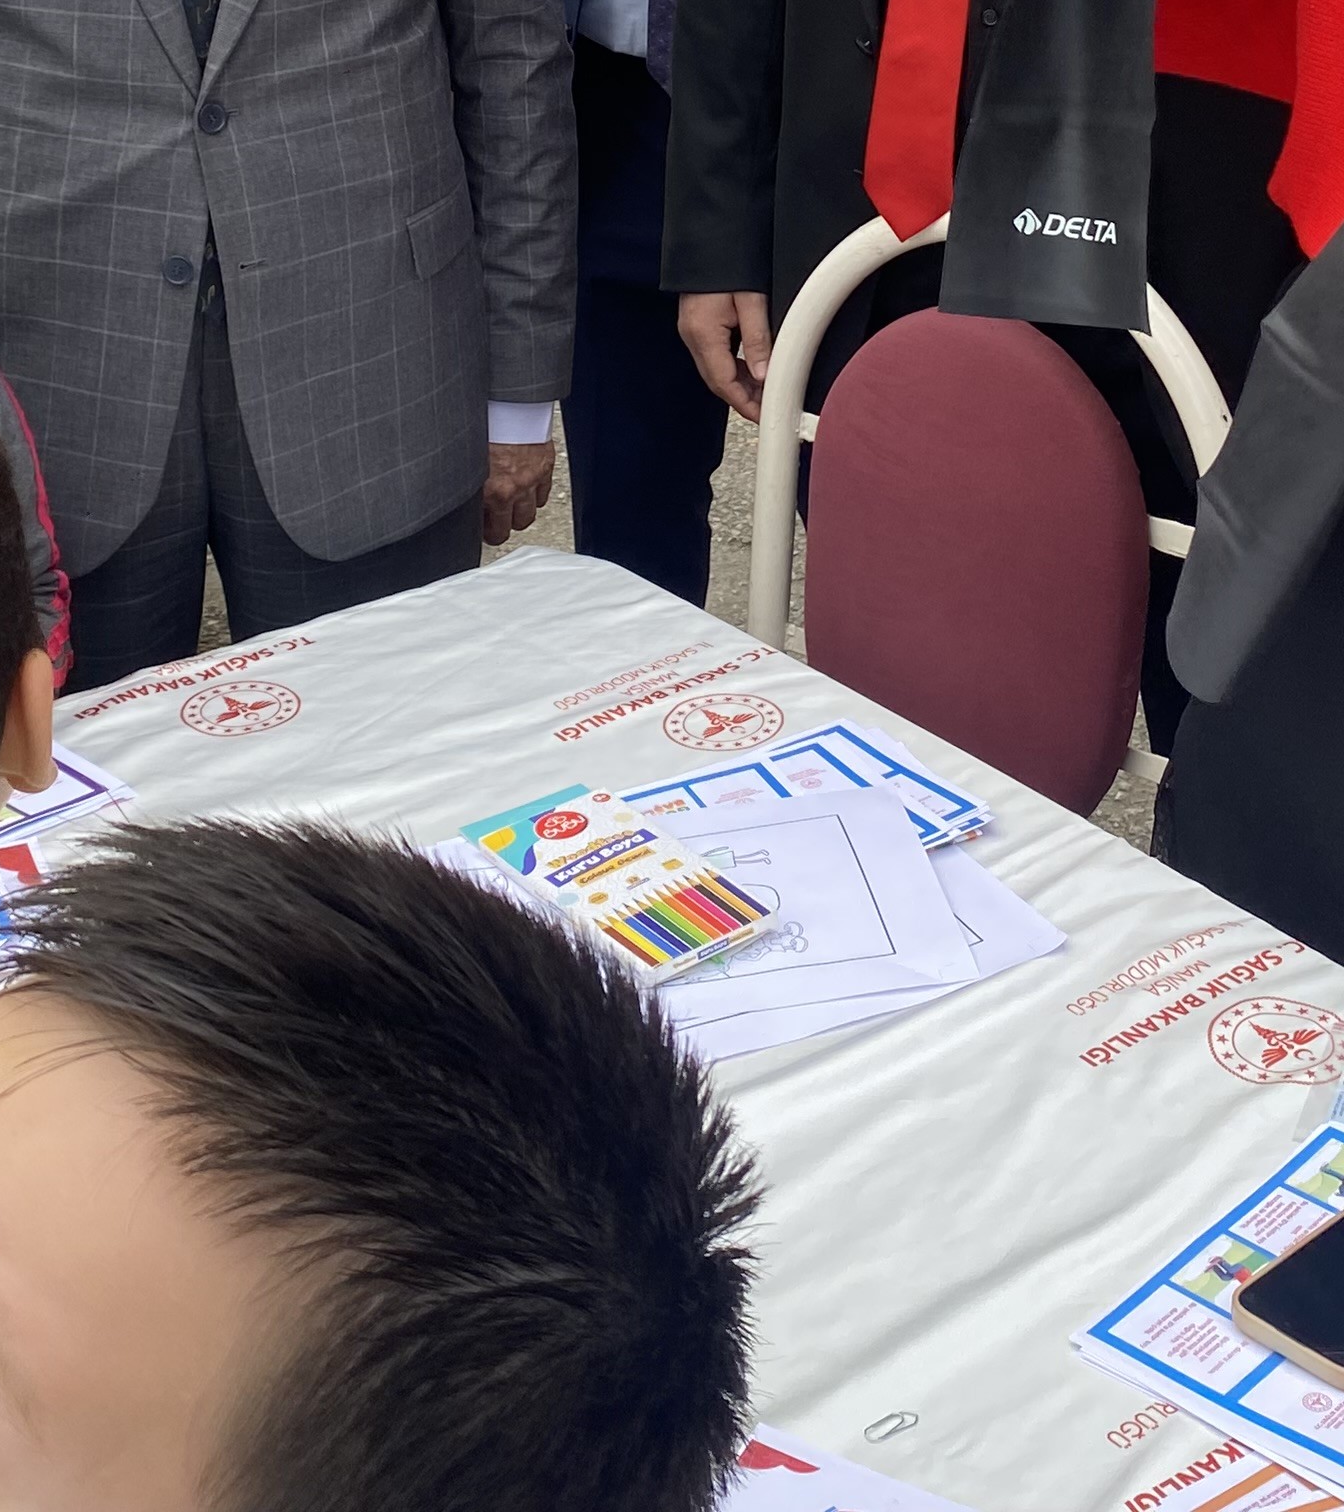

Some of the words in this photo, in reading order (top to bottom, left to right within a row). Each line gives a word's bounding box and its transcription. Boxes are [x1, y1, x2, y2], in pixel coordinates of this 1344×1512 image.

[1042, 213, 1117, 244] DELTA
[201, 648, 275, 682] SAĞLIK
[673, 661, 740, 694] SAĞLIK
[736, 646, 778, 663] T.C.
[73, 675, 197, 721] BAKANLIĞI
[619, 669, 681, 697] MANİSA
[553, 690, 669, 743] BAKANLIĞI
[554, 854, 601, 882] Kuru
[599, 833, 645, 858] Boya
[1164, 926, 1227, 960] SAĞLIK
[1066, 952, 1172, 1017] MÜDÜRLÜĞÜ
[1142, 959, 1212, 997] MANİSA
[1197, 949, 1284, 1000] SAĞLIK
[1078, 992, 1207, 1068] BAKANLIĞI
[1107, 1401, 1180, 1449] RLÜĞÜ
[1124, 1438, 1255, 1512] KANLIĞI
